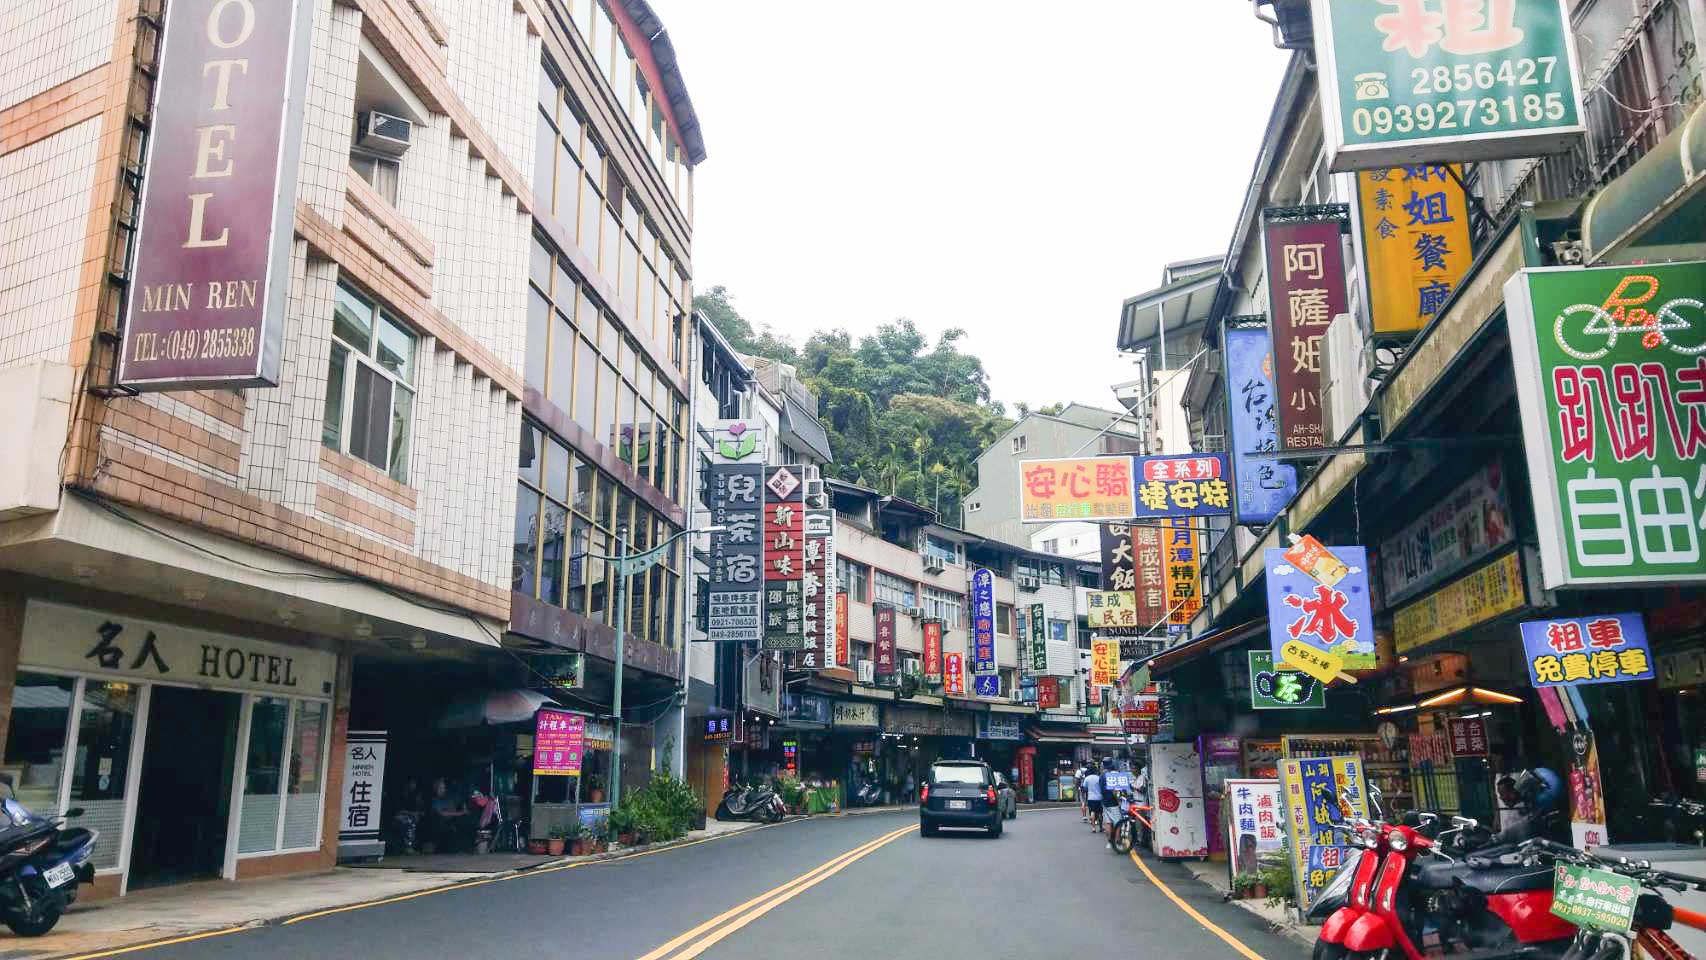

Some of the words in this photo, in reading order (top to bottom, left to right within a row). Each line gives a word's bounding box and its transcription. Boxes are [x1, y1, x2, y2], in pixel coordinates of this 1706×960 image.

[1410, 56, 1558, 96] 2856427
[1352, 92, 1565, 136] 0939273185
[141, 283, 193, 313] MIN
[206, 280, 259, 310] REN
[1284, 244, 1331, 374] 阿薩姆
[1025, 462, 1130, 500] 安心騎
[1151, 459, 1213, 480] 全系列
[1138, 476, 1231, 511] 捷安特
[1567, 465, 1706, 567] 自由
[773, 505, 794, 576] 新山味
[768, 590, 782, 626] 邵族
[1090, 593, 1120, 608] 建成
[1103, 609, 1135, 625] 民宿
[1284, 585, 1358, 643] 冰
[85, 620, 171, 675] 名人
[1547, 619, 1626, 653] 租車
[199, 643, 298, 688] HOTEL
[1093, 642, 1109, 685] 安心騎
[1532, 649, 1650, 684] 免費停車
[351, 746, 377, 761] 名人
[348, 780, 373, 828] 住宿
[1236, 787, 1256, 831] 牛肉麵
[1257, 794, 1276, 839] 滷肉飯
